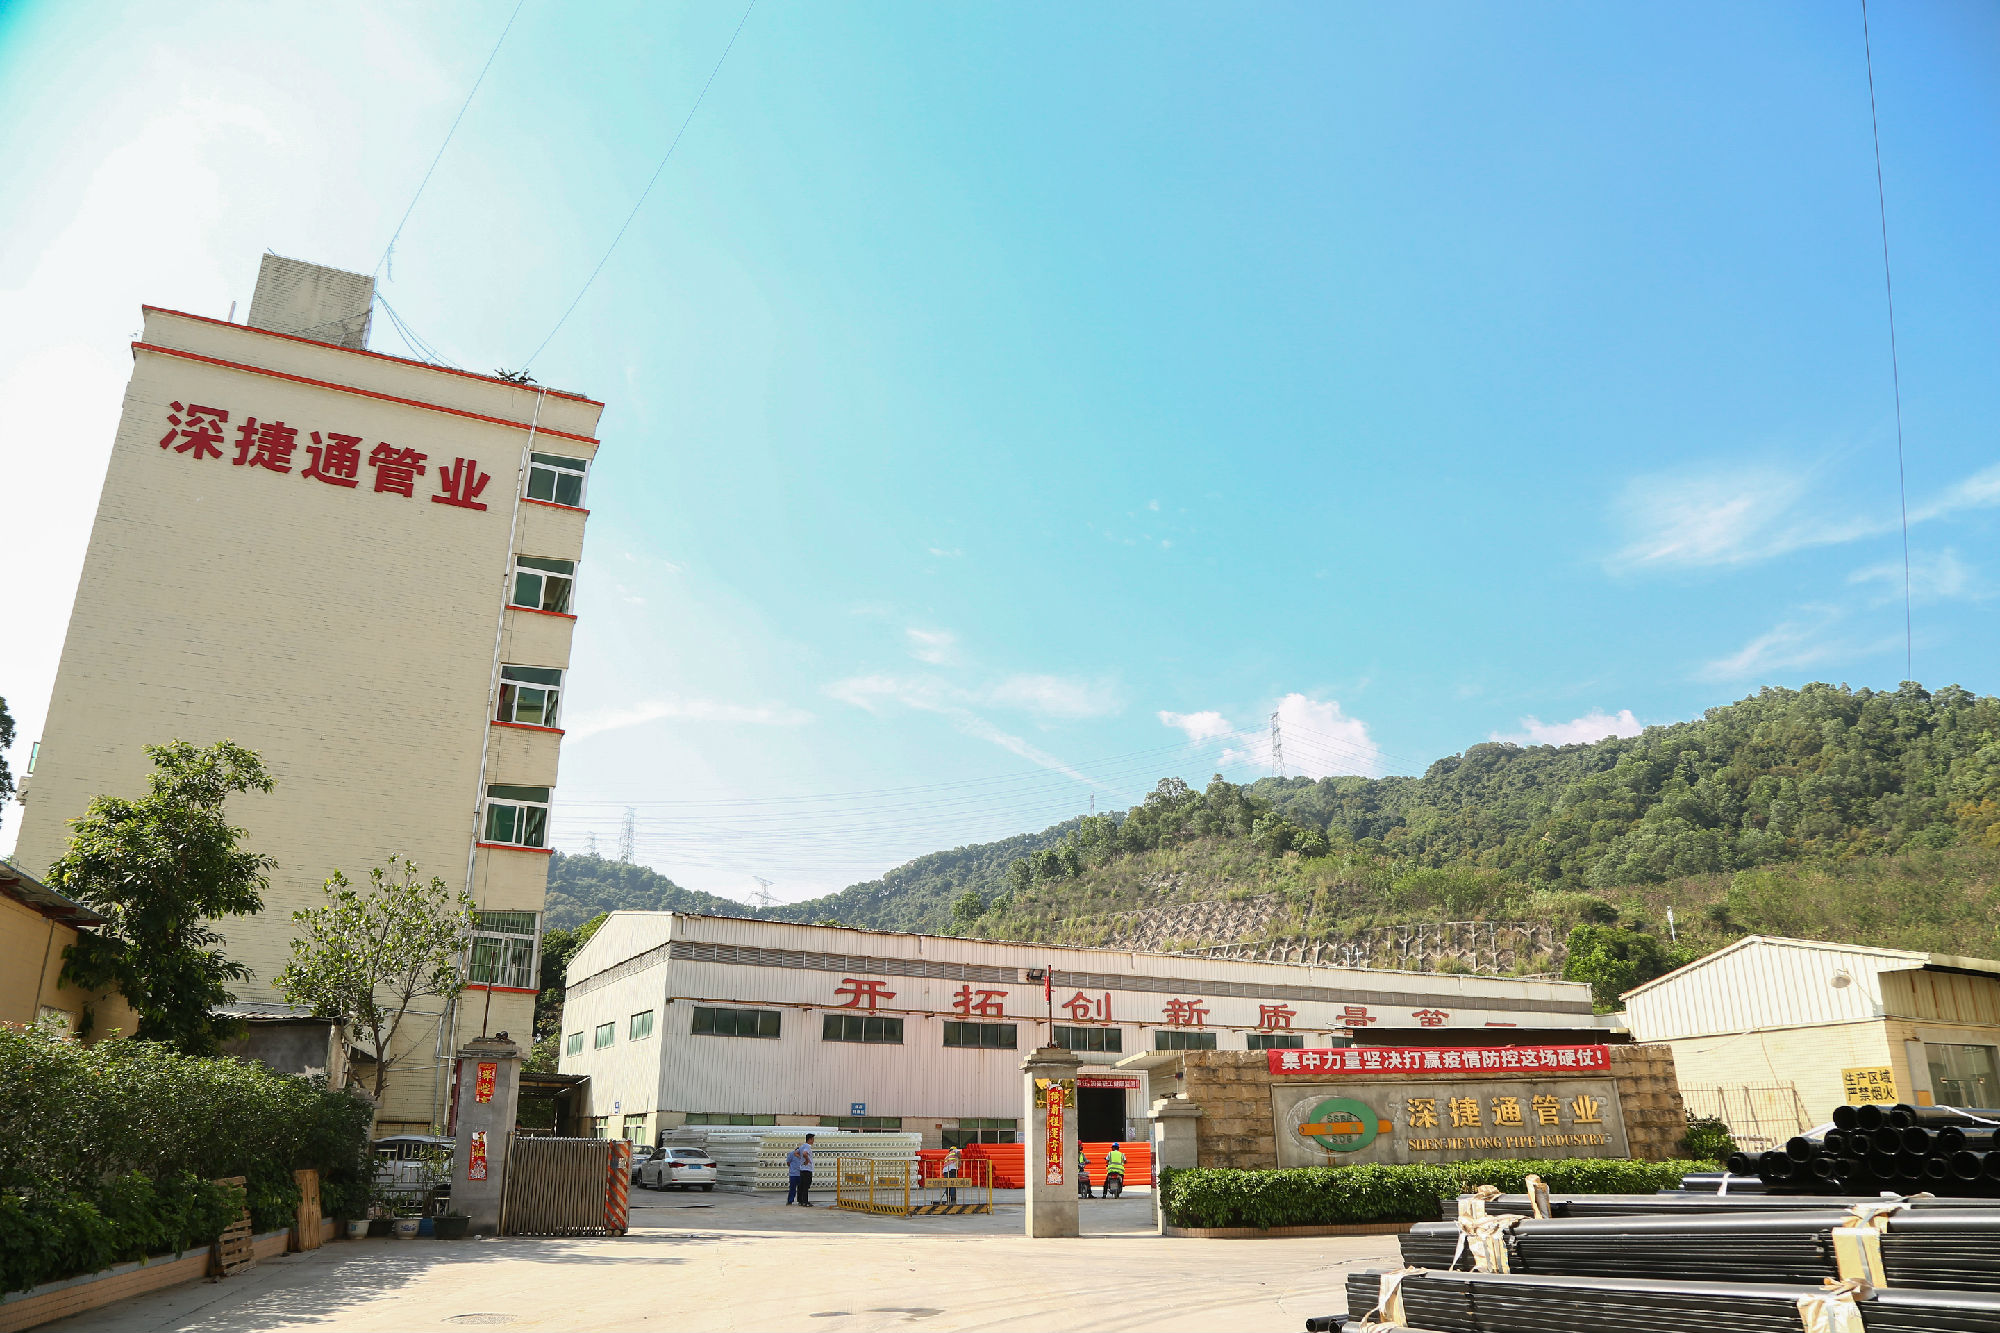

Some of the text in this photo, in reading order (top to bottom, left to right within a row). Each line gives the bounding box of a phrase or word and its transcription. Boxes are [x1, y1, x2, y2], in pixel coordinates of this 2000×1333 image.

[160, 400, 491, 511] 深捷通管业
[1281, 1048, 1603, 1070] 集中力量坚决打赢疫情防控这场硬仗!
[1846, 1069, 1892, 1085] 生产区域
[1847, 1085, 1895, 1101] 严禁烟火
[1407, 1094, 1603, 1129] 深捷通管业
[1505, 1135, 1537, 1149] PIPE
[1541, 1133, 1606, 1146] INDUSTRY
